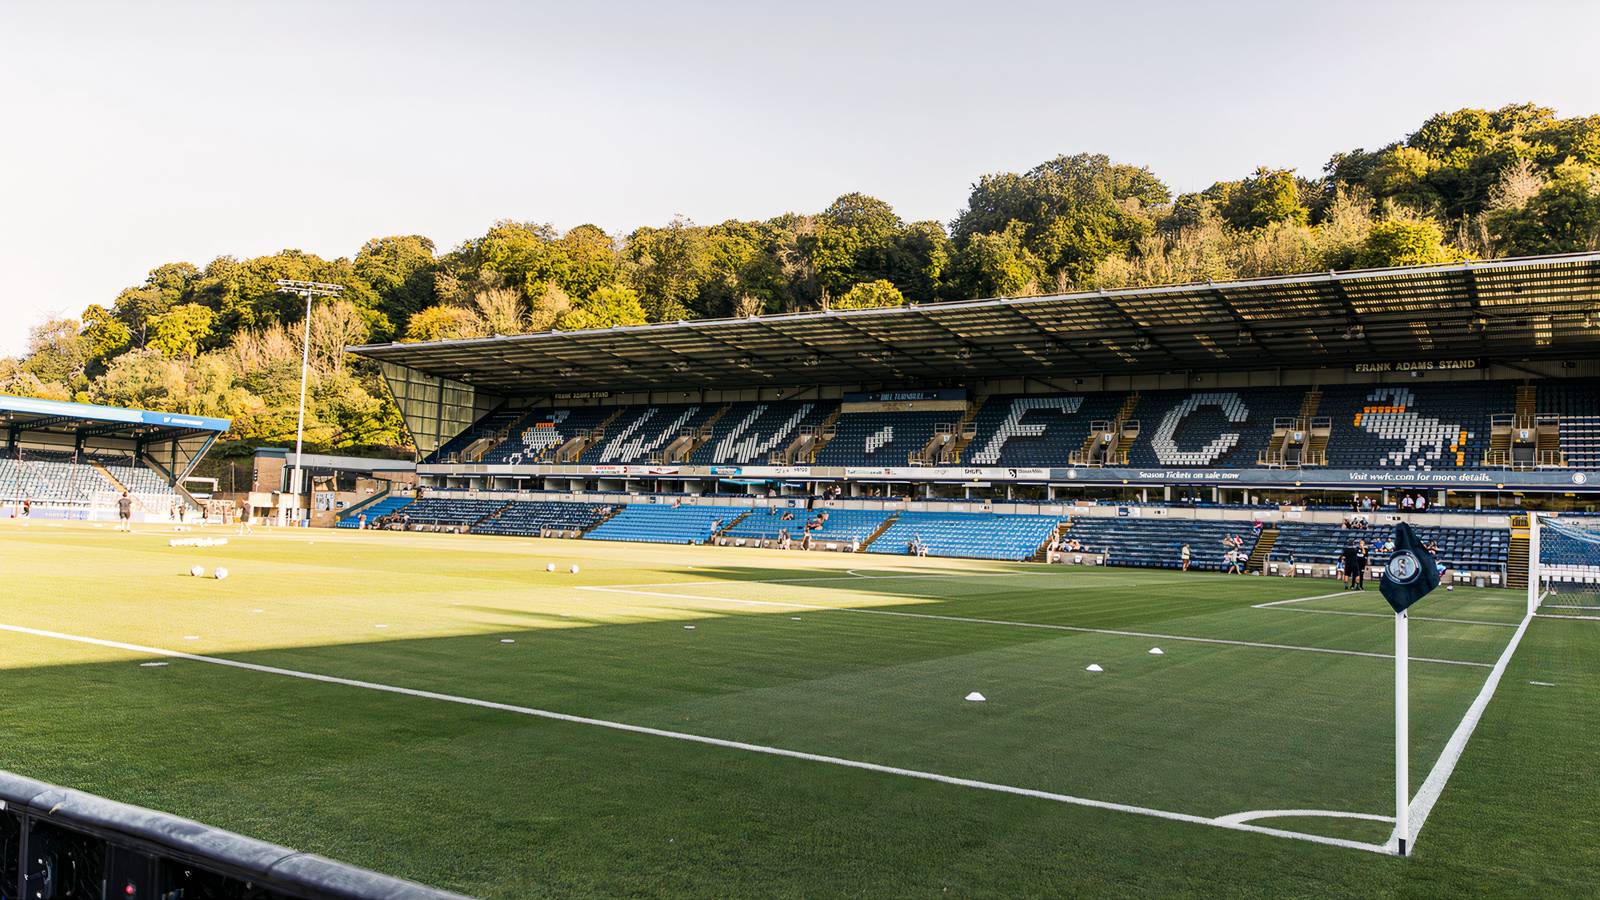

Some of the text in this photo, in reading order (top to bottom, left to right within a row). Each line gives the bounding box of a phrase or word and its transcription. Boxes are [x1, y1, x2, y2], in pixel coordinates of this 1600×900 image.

[1355, 359, 1476, 372] FRANK ADAMS STAND
[1166, 471, 1191, 479] Tickets
[1349, 472, 1367, 480] Visit
[1370, 472, 1415, 481] wwfc.com
[1417, 472, 1430, 481] for
[1458, 473, 1492, 482] details.
